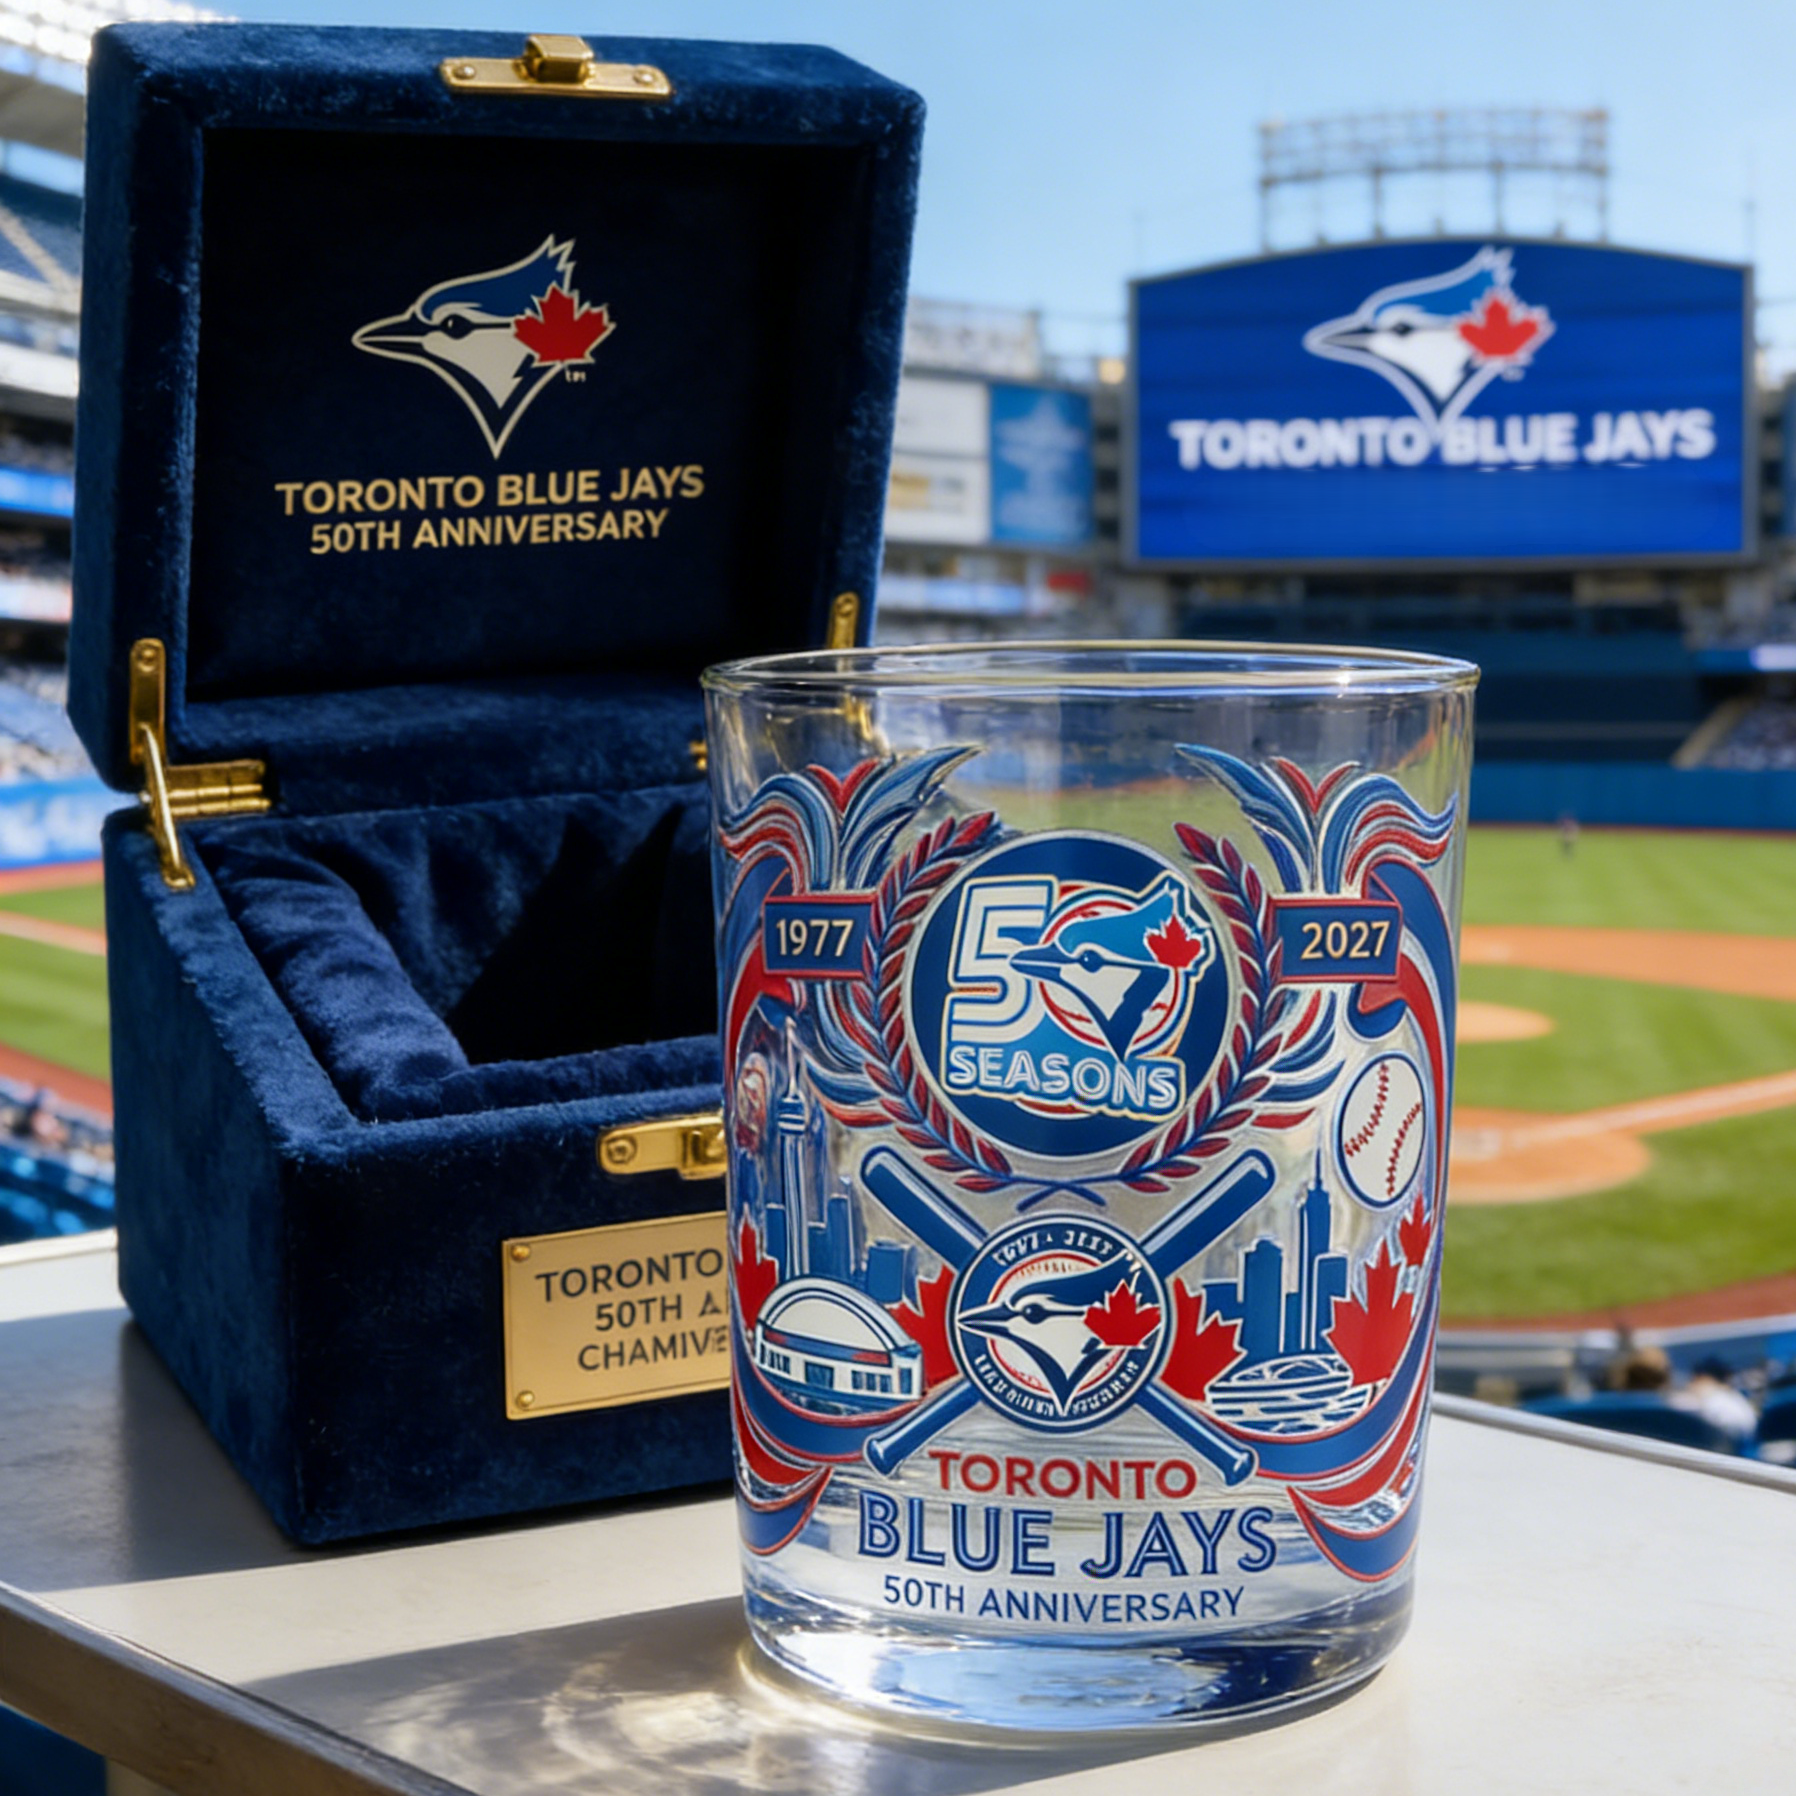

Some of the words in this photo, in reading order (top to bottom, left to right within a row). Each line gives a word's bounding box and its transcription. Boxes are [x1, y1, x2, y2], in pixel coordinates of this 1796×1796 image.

[1168, 416, 1432, 471] TORONTO
[1441, 411, 1578, 465] BLUE
[1584, 408, 1716, 461] JAYS
[274, 475, 485, 516] TORONTO
[497, 470, 600, 506] BLUE
[610, 464, 704, 501] JAYS
[310, 520, 401, 554] 50TH
[412, 508, 669, 548] ANNIVERSARY
[776, 918, 854, 957] 1977
[1300, 921, 1390, 960] 2027
[948, 1044, 1180, 1111] SEASONS
[535, 1248, 724, 1303] TORONTO
[595, 1294, 682, 1332] 50TH
[698, 1290, 729, 1318] A
[928, 1449, 1197, 1500] TORONTO
[858, 1488, 1055, 1577] BLUE
[1080, 1506, 1277, 1580] JAYS
[883, 1574, 964, 1614] 50TH
[978, 1585, 1244, 1624] ANNIVERSARY
